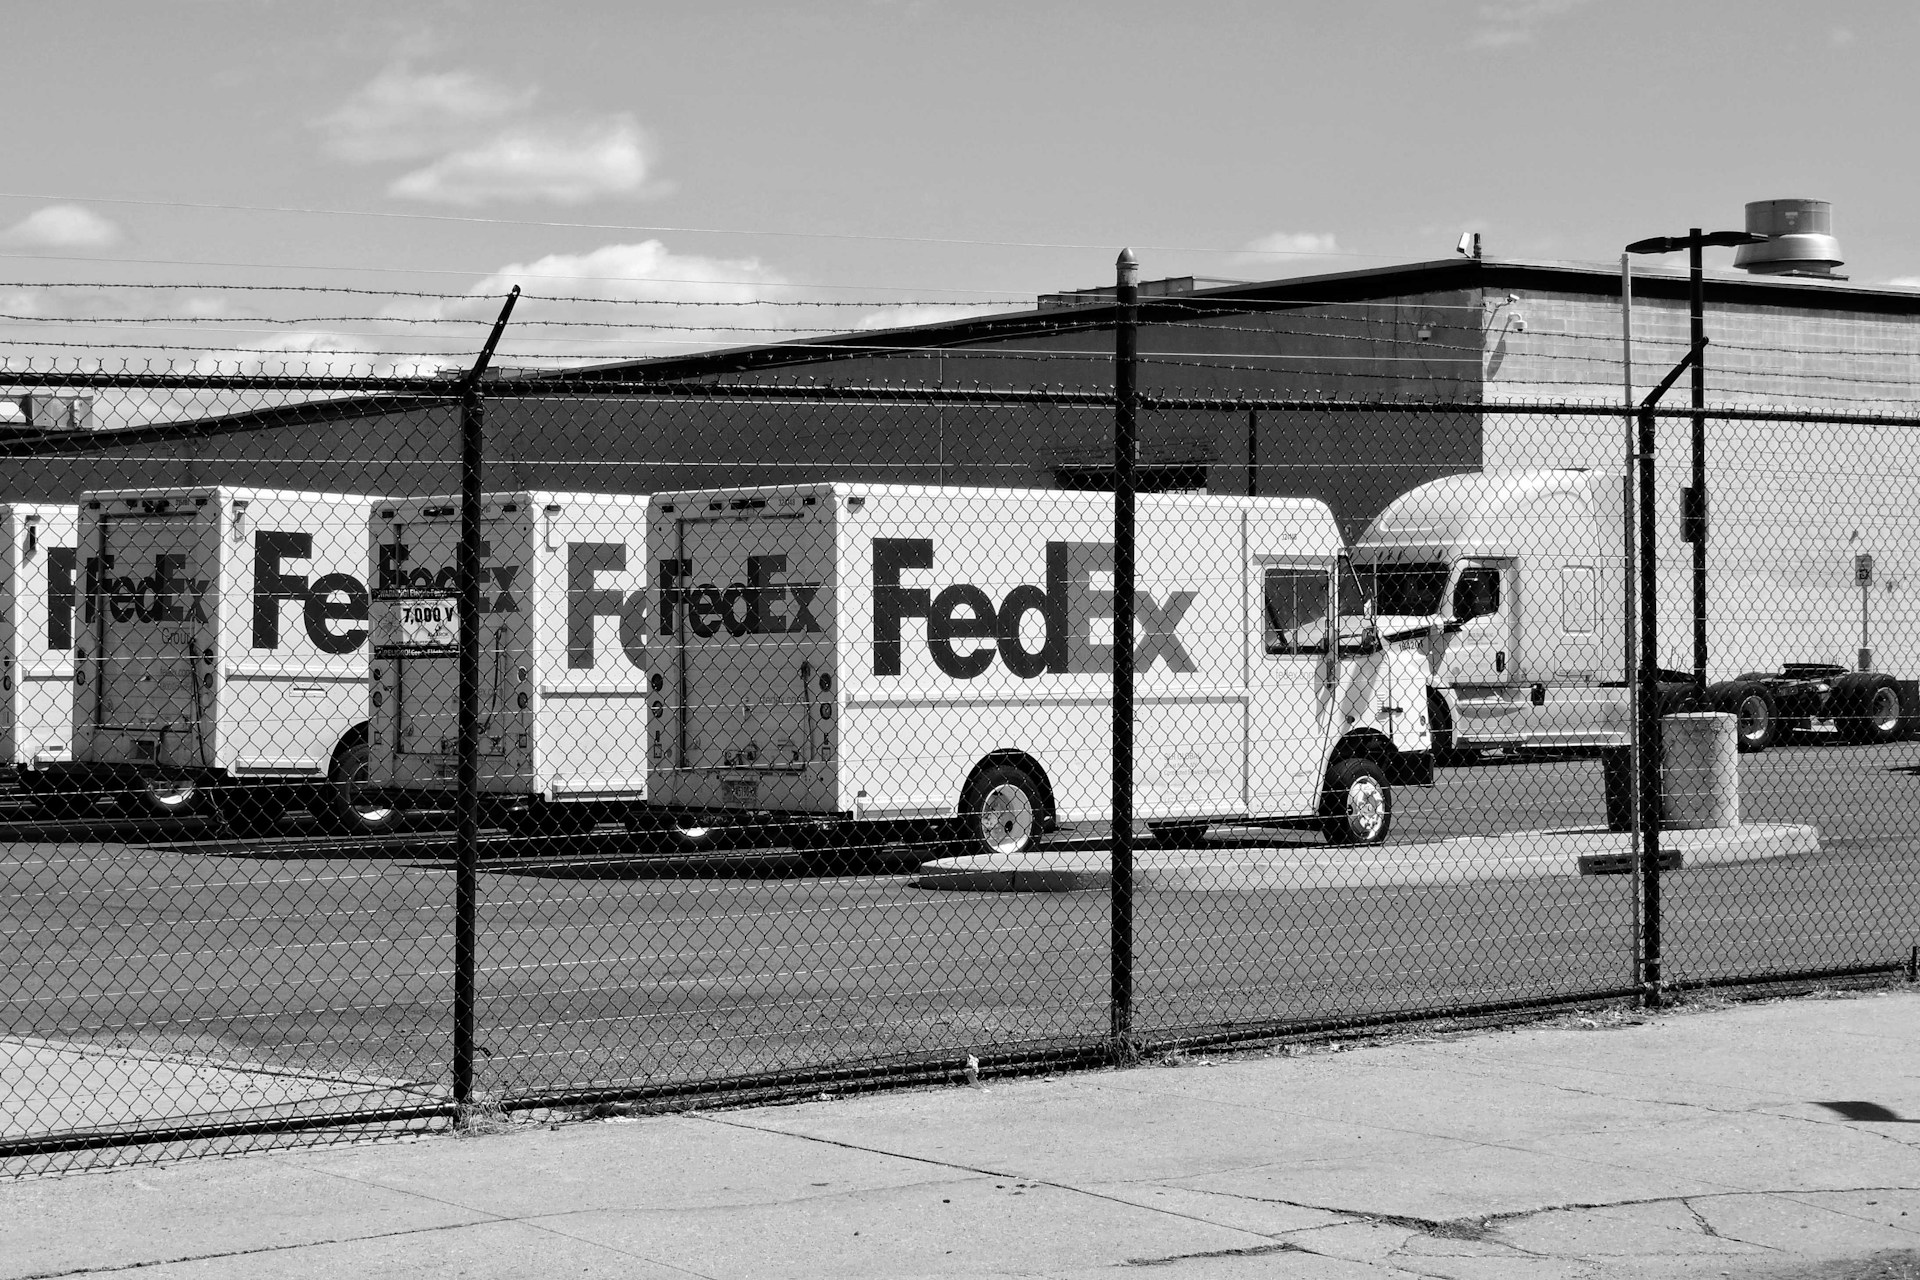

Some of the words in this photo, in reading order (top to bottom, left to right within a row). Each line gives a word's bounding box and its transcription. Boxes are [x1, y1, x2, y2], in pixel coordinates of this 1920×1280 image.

[85, 553, 209, 623] FedEx
[403, 607, 441, 625] 7,000
[445, 607, 454, 622] V
[660, 554, 822, 638] FedEx
[873, 538, 1199, 679] FedEx
